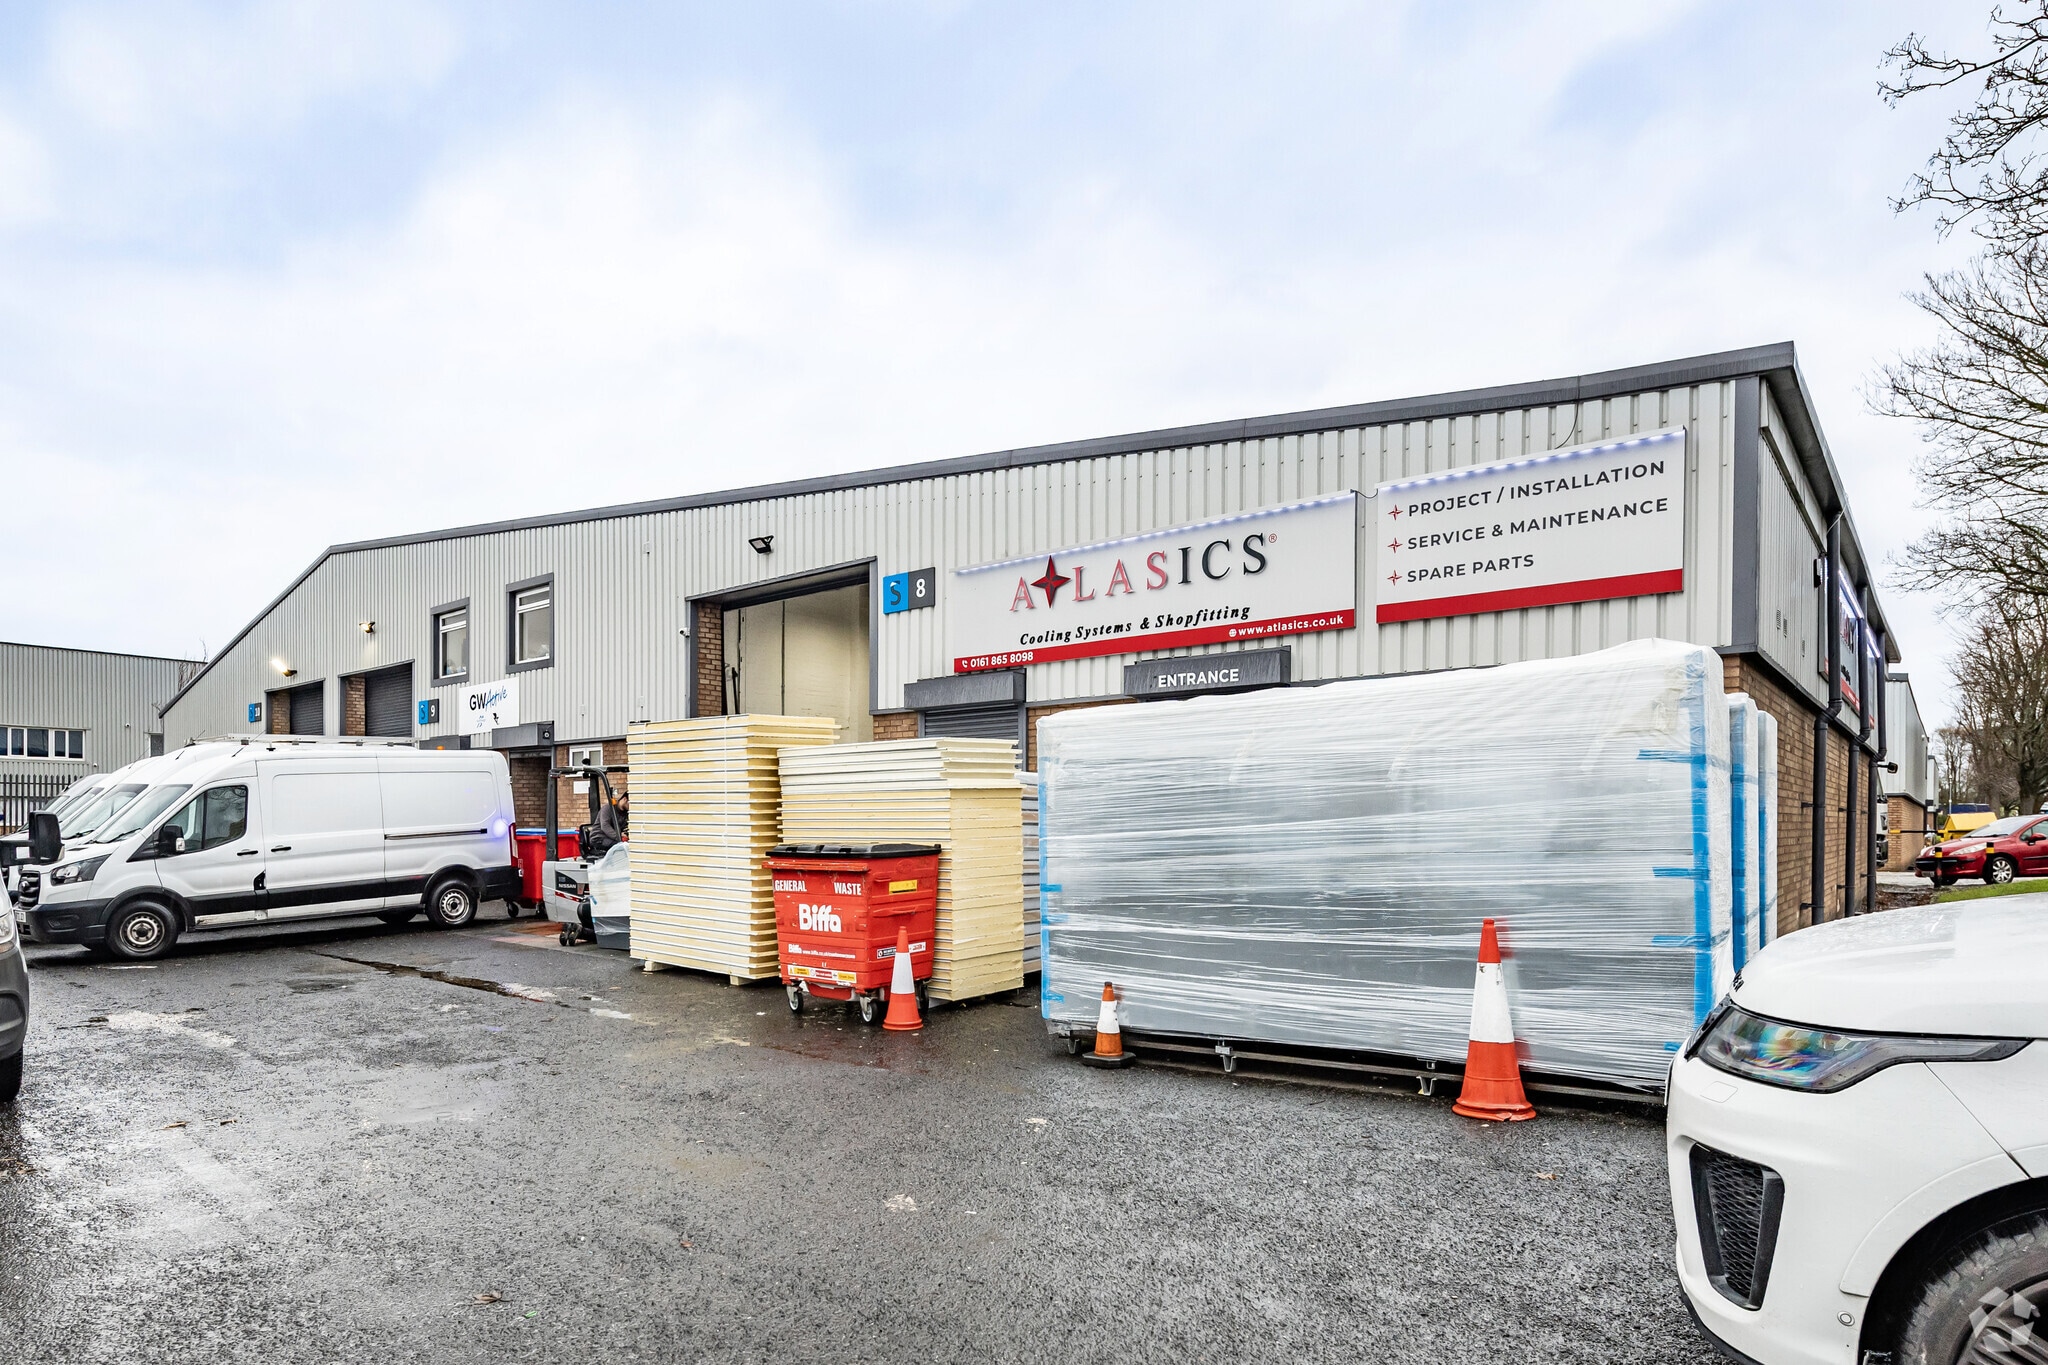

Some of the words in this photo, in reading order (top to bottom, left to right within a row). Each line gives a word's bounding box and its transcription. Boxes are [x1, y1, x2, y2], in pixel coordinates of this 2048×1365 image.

[1408, 491, 1492, 517] PROJECT
[1496, 486, 1505, 504] /
[1510, 460, 1665, 500] INSTALLATION
[1407, 526, 1486, 550] SERVICE
[1491, 524, 1504, 538] &
[1510, 498, 1669, 535] MAINTENANCE
[1407, 563, 1467, 583] SPARE
[1472, 554, 1535, 574] PARTS
[916, 578, 926, 598] 8
[1020, 629, 1072, 646] Cooling
[1075, 621, 1132, 640] Systems
[1140, 617, 1150, 630] &
[1155, 605, 1251, 628] Shopfitting
[1238, 614, 1344, 637] www.atlasics.co.uk
[970, 656, 989, 668] 0161
[991, 654, 1008, 666] 865
[1010, 651, 1034, 664] 8098
[1158, 668, 1240, 688] ENTRANCE
[430, 704, 436, 717] 9
[774, 880, 807, 892] GENERAL
[833, 881, 862, 896] WASTE
[799, 903, 842, 933] Biffa
